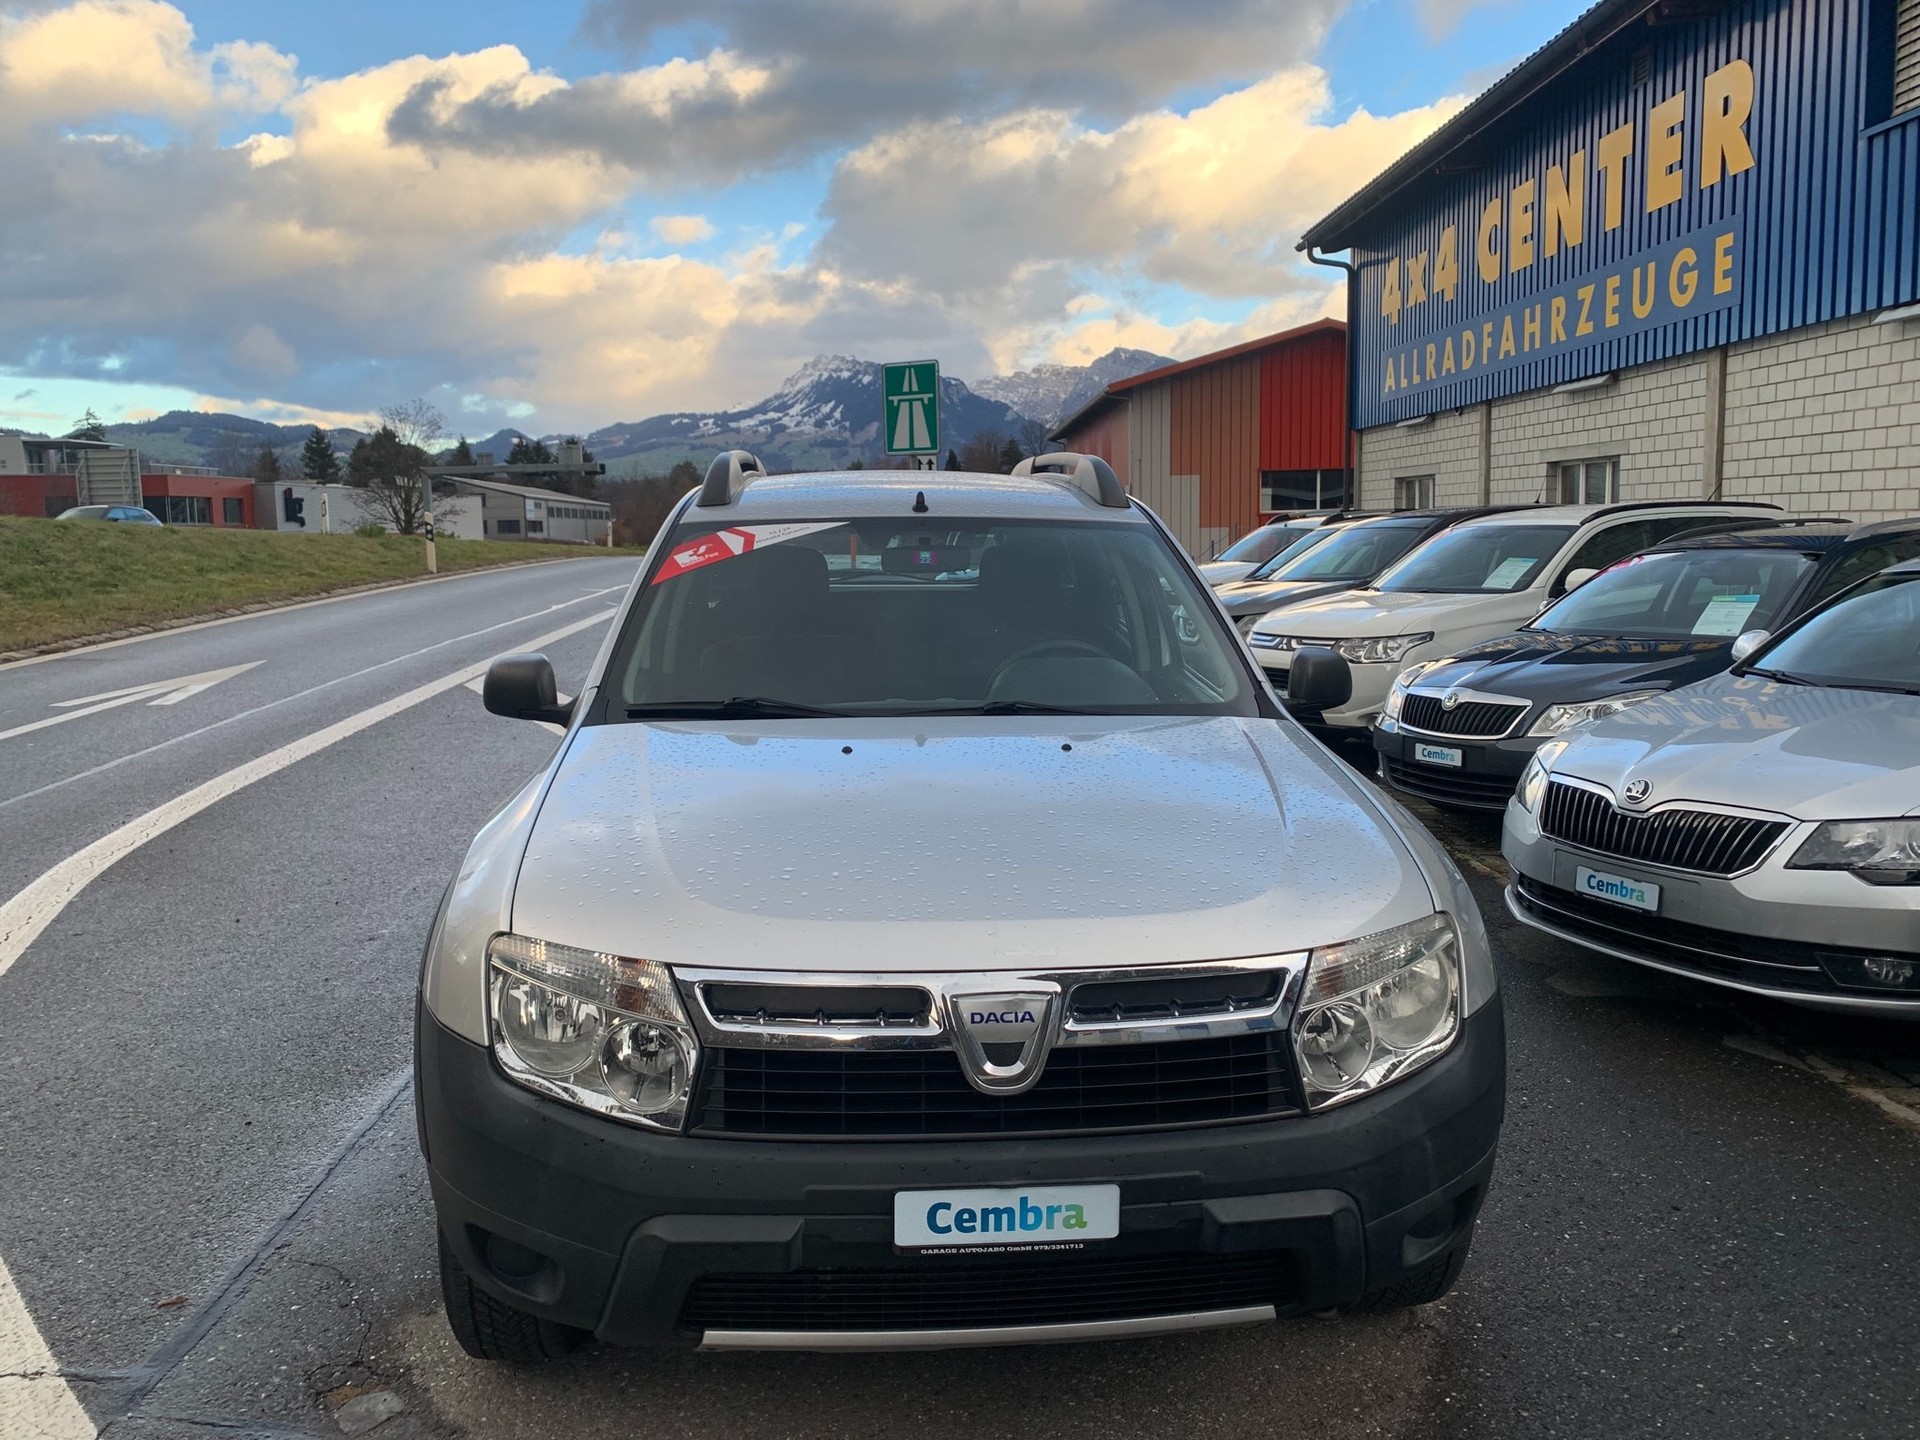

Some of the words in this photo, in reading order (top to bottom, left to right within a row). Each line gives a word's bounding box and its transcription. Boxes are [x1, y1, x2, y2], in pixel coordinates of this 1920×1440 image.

[1477, 58, 1756, 284] CENTER
[1384, 232, 1735, 393] ALLRADFAHRZEUGE
[1422, 747, 1455, 762] Cembra
[1586, 874, 1646, 904] Cembra
[970, 1010, 1035, 1025] DACIA
[926, 1195, 1088, 1235] Cembra
[959, 1246, 1006, 1254] AUTOJARO
